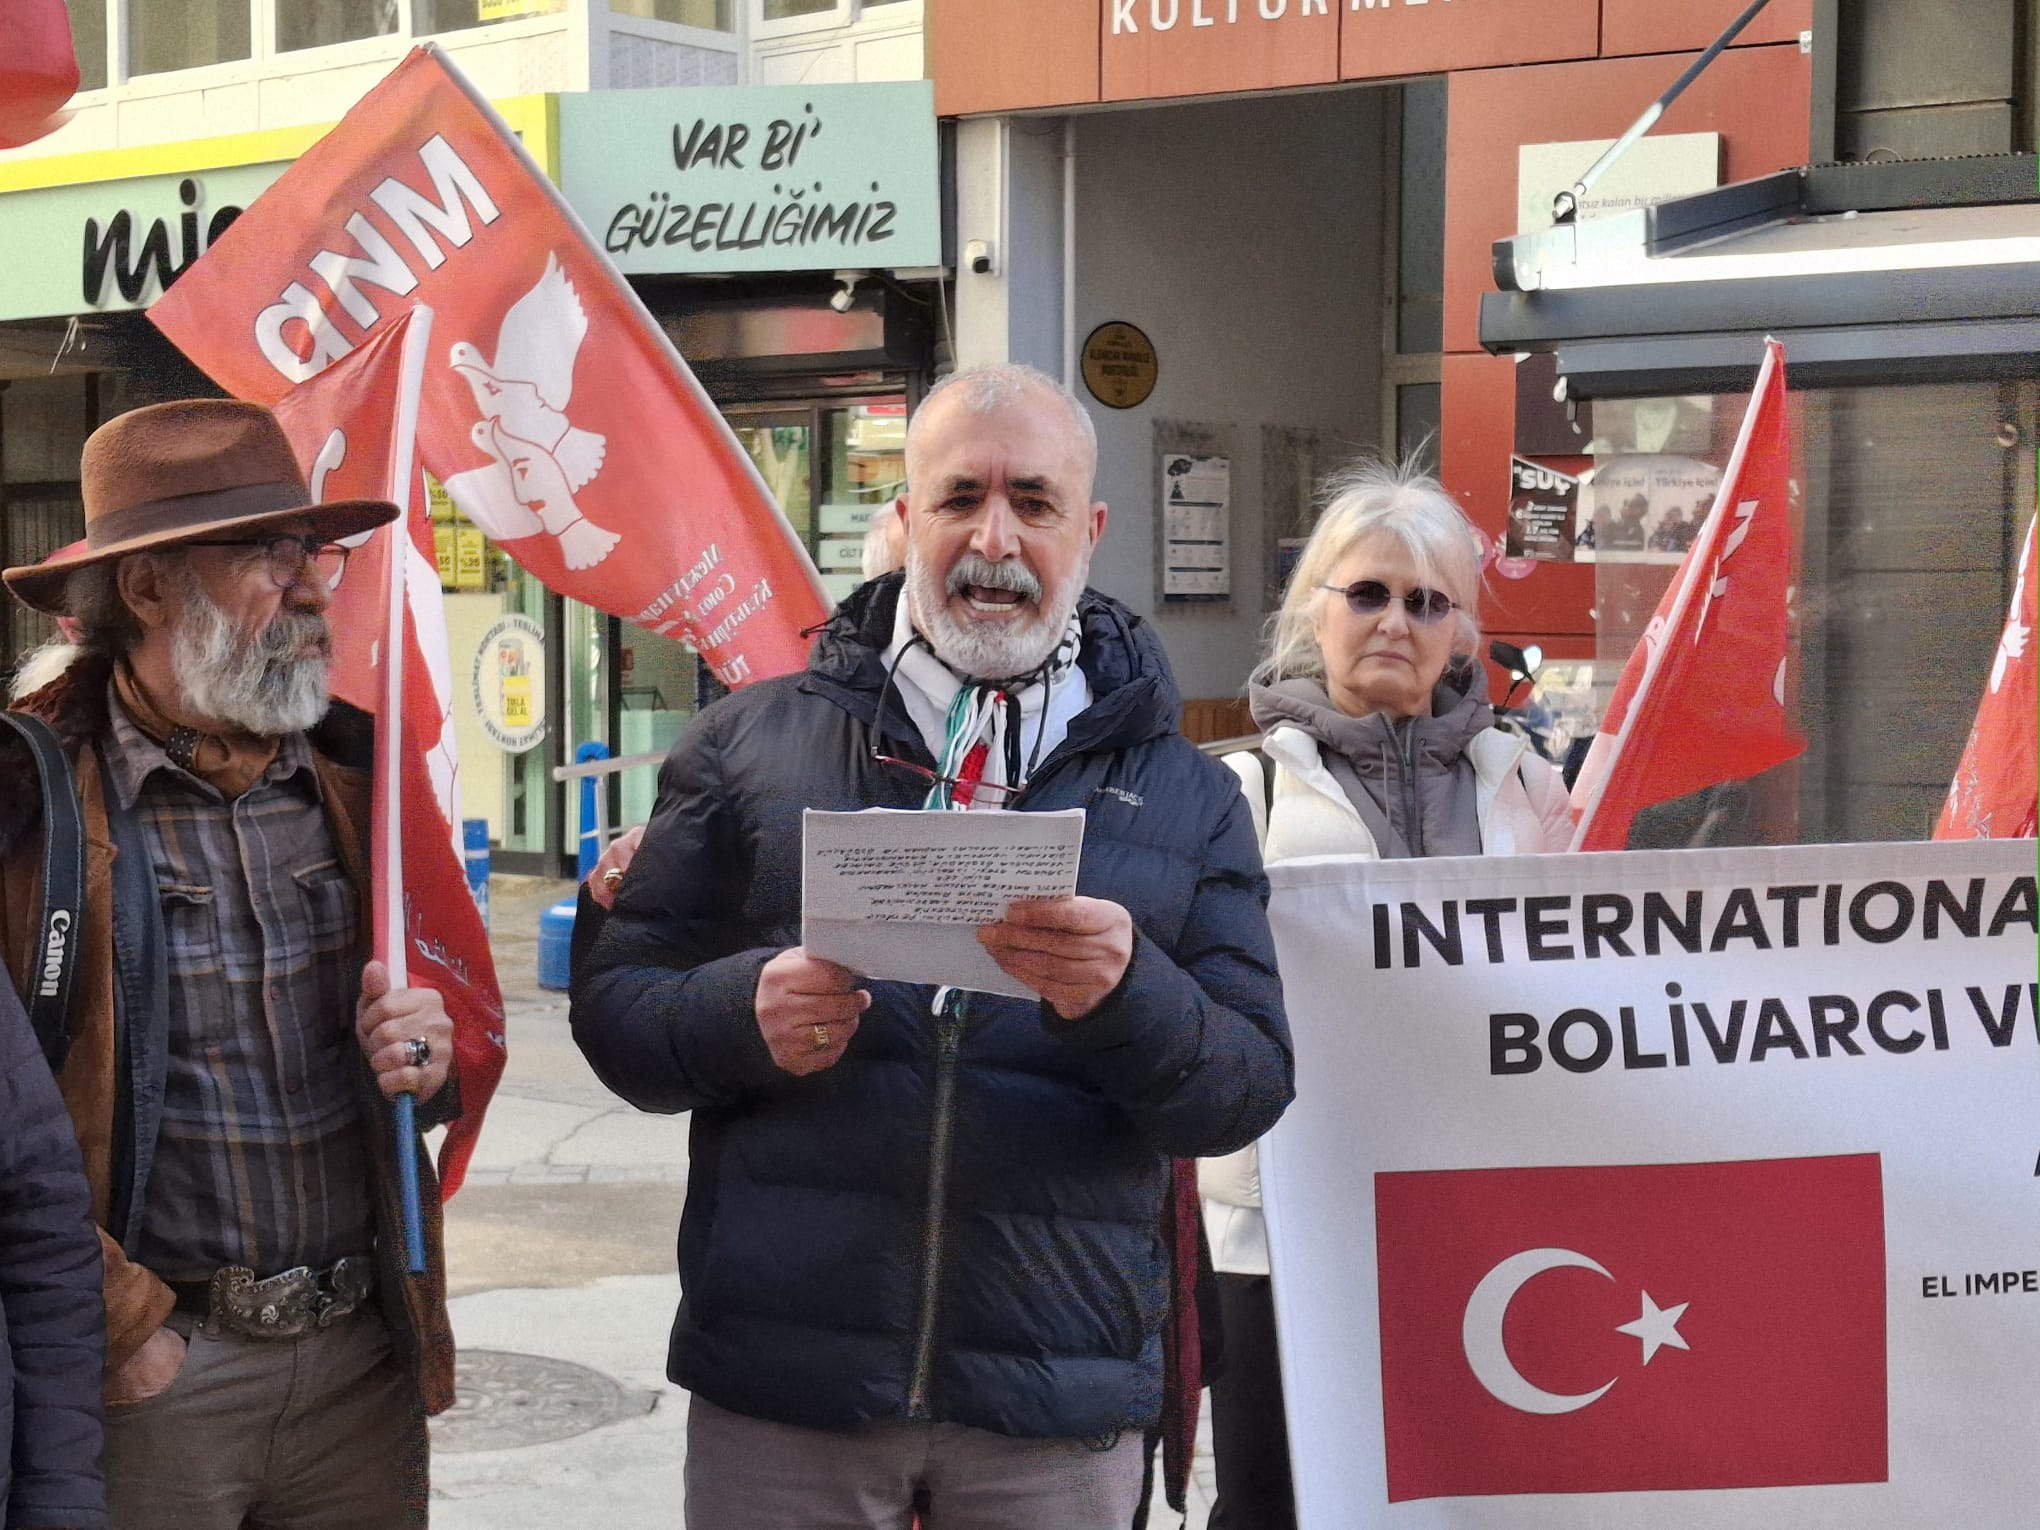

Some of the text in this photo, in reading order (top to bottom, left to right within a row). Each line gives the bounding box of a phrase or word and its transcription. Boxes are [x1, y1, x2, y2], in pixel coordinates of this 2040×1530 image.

[671, 119, 750, 170] VAR
[605, 182, 899, 255] GÜZELLİĞİMİZ
[1602, 197, 1631, 209] kalan
[39, 909, 71, 996] Canon
[1372, 876, 2039, 970] INTERNATIONA
[1490, 981, 2039, 1076] BOLİVARCI V
[1922, 1275, 1958, 1299] EL
